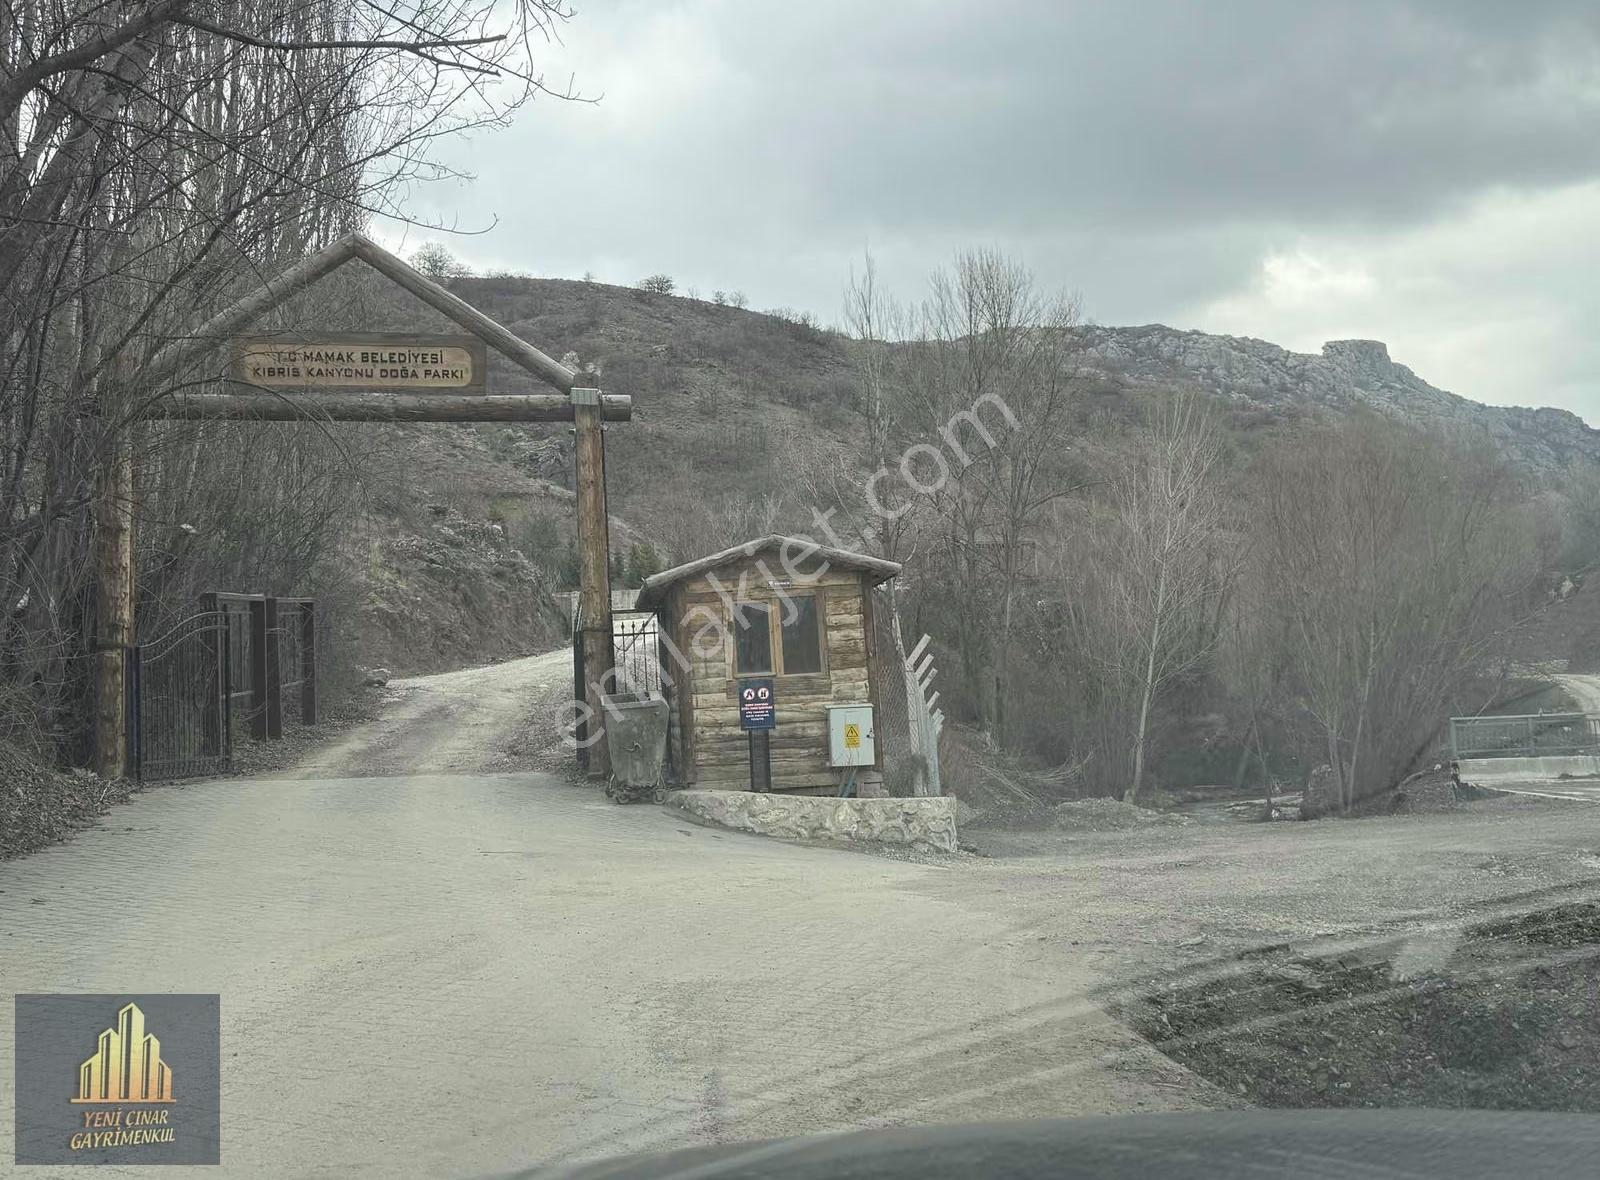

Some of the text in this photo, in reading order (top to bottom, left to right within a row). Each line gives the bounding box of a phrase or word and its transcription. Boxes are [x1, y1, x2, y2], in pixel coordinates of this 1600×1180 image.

[303, 351, 355, 363] MAMAK
[361, 350, 444, 364] BELEDİYESİ
[253, 366, 464, 379] KIBRIS KANYONU DOĞA PARKI
